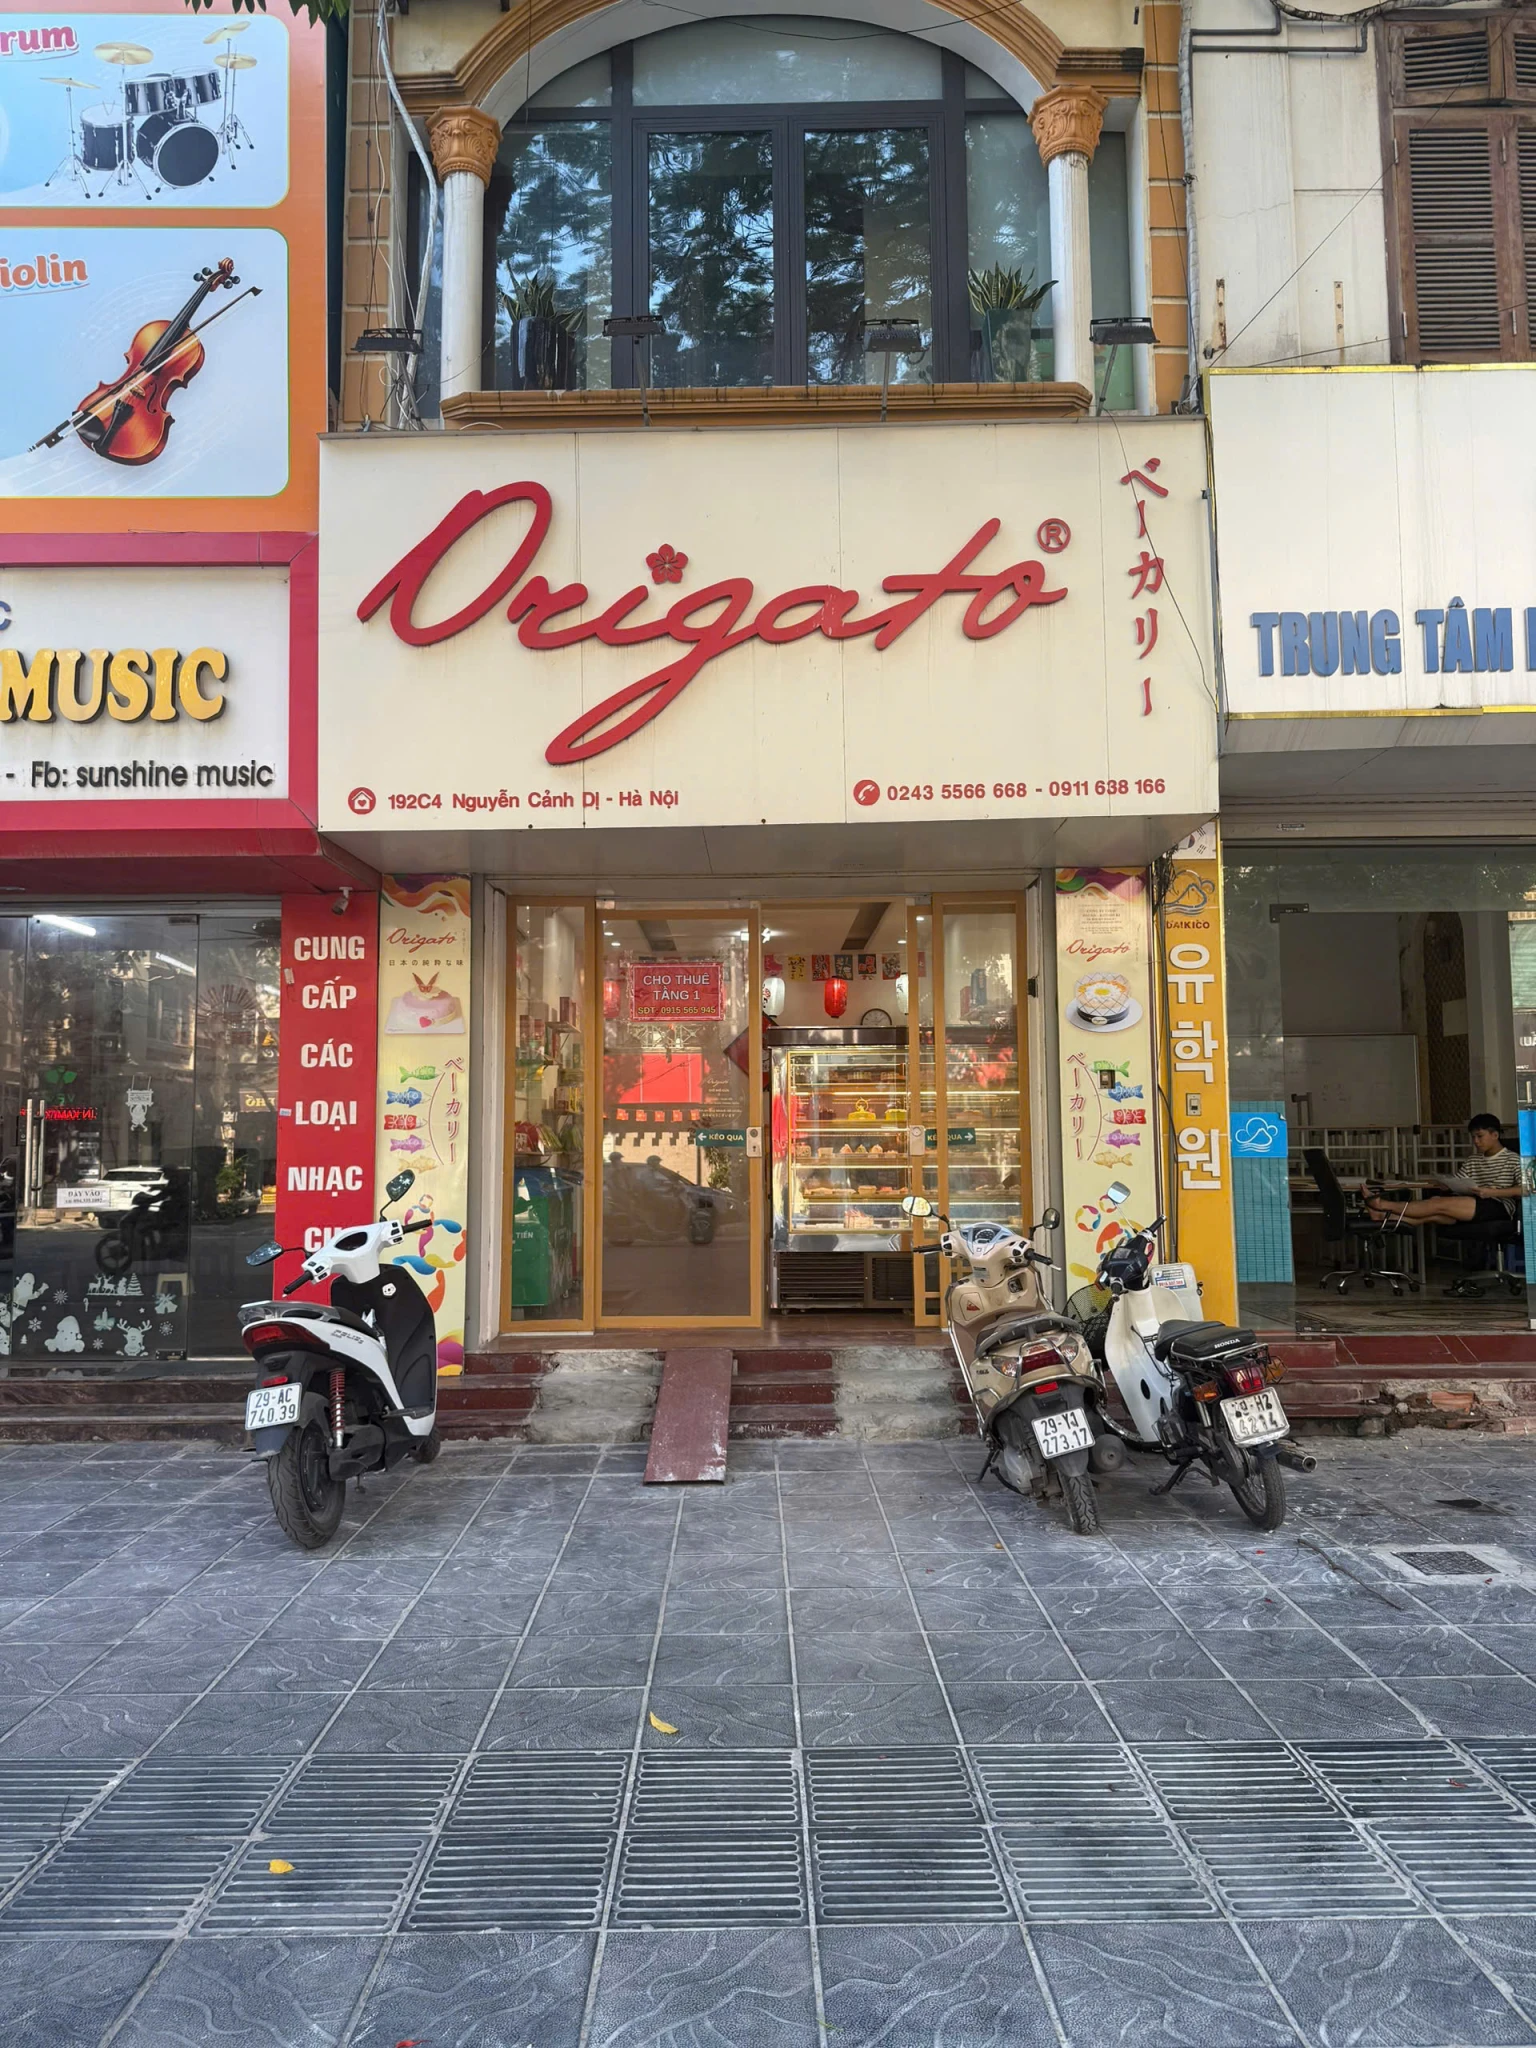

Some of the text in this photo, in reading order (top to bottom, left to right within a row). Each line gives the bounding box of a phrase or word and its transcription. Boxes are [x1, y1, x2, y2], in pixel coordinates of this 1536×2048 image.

[357, 480, 1068, 766] Origato
[1251, 609, 1402, 677] TRUNG
[1416, 596, 1514, 674] TÂM
[0, 648, 229, 723] MUSIC
[31, 760, 68, 787] Fb:
[76, 760, 188, 787] sunshine
[197, 760, 274, 787] music
[388, 793, 442, 809] 192C4
[453, 789, 520, 812] Nguyễn
[528, 789, 574, 808] Cảnh
[583, 791, 600, 810] Dị
[619, 790, 643, 806] Hà
[650, 790, 679, 808] Nội
[887, 785, 934, 800] 0243
[941, 783, 986, 799] 5566
[992, 782, 1028, 798] 668
[1049, 780, 1089, 796] 0911
[1094, 779, 1129, 795] 638
[1138, 778, 1166, 794] 166
[294, 936, 365, 961] CUNG
[386, 927, 457, 953] Origato
[1066, 939, 1131, 962] Origato
[643, 972, 710, 985] CHO THUÊ
[302, 976, 357, 1009] CẤP
[653, 985, 700, 1000] TẦNG 1
[661, 1006, 681, 1014] 0915
[300, 1038, 353, 1068] CÁC
[295, 1100, 357, 1131] LOẠI
[726, 1134, 744, 1142] QUA
[287, 1166, 363, 1197] NHẠC
[1214, 1338, 1241, 1349] HONDA
[255, 1387, 293, 1408] 29-AC
[250, 1403, 296, 1426] 740.39
[1042, 1427, 1087, 1455] 273.17
